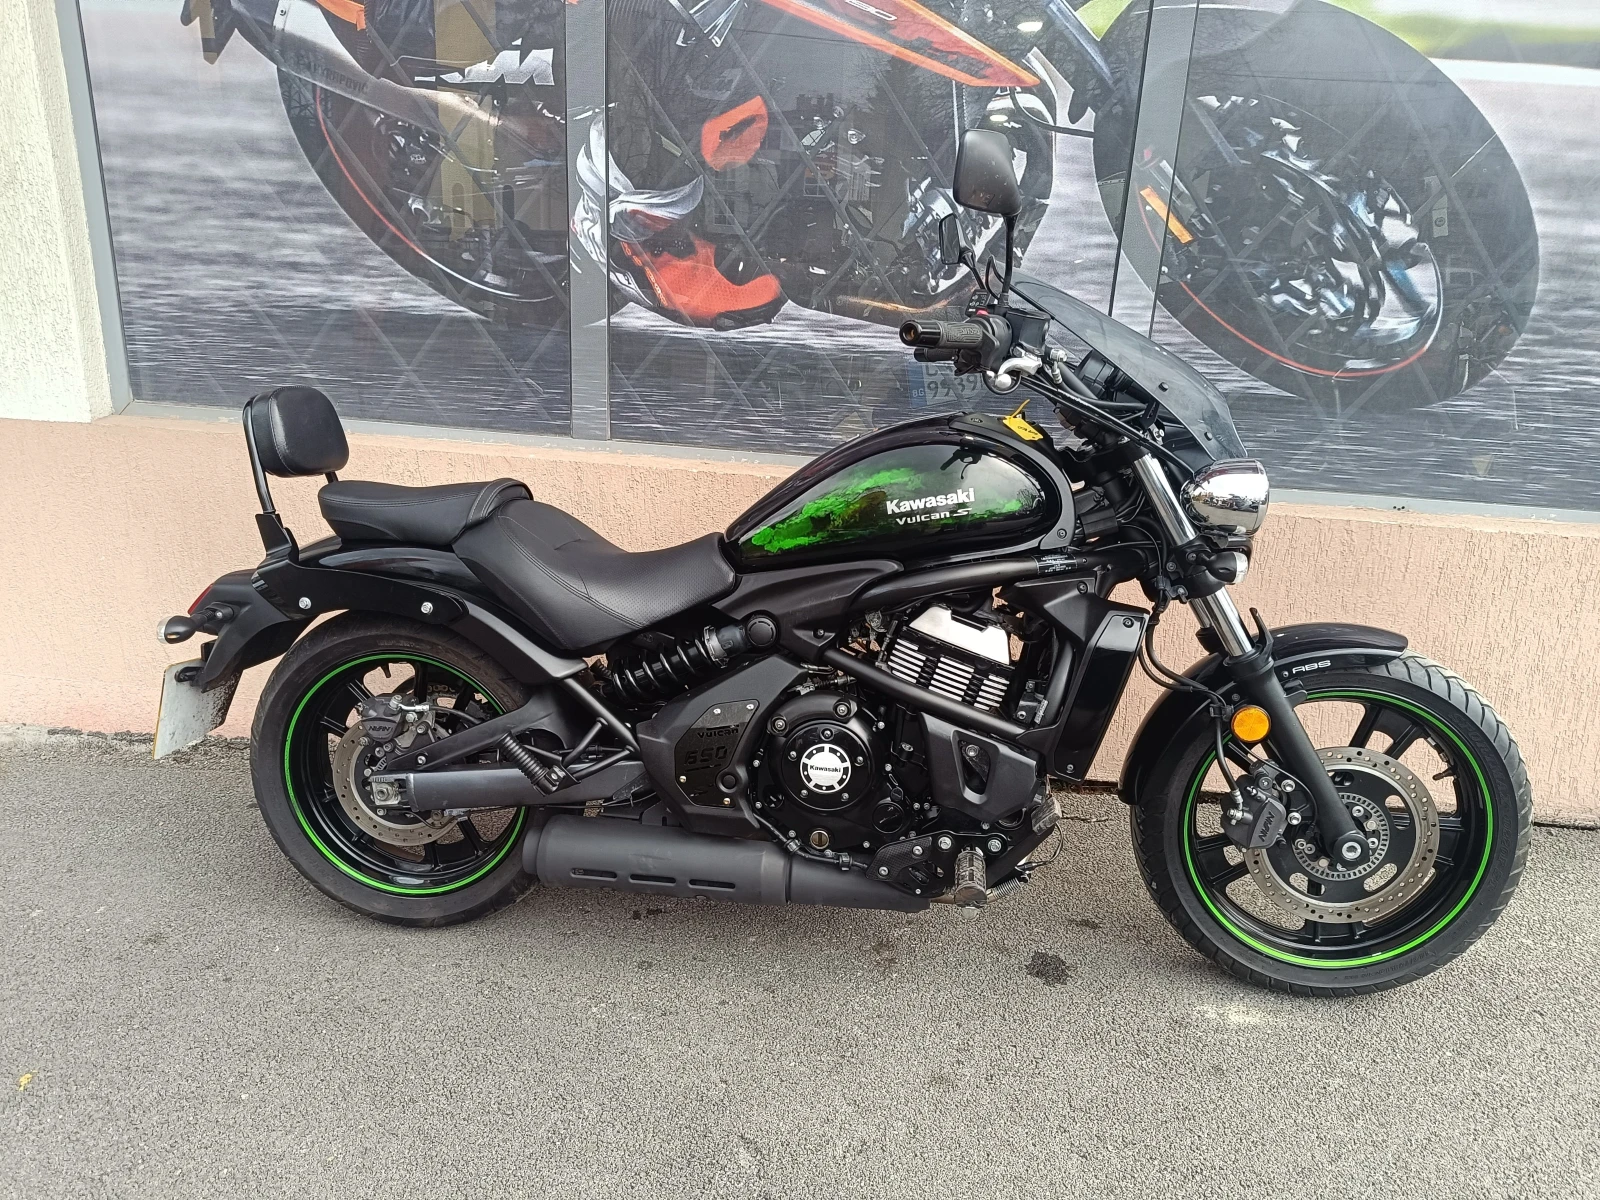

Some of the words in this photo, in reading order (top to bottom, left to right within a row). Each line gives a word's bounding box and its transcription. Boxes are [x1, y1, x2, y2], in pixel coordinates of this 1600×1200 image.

[886, 487, 976, 515] Kawasaki
[896, 511, 951, 525] Vulcan
[952, 507, 973, 517] S
[1292, 660, 1331, 674] ABS
[685, 745, 728, 765] 650
[809, 764, 842, 773] Kawasaki
